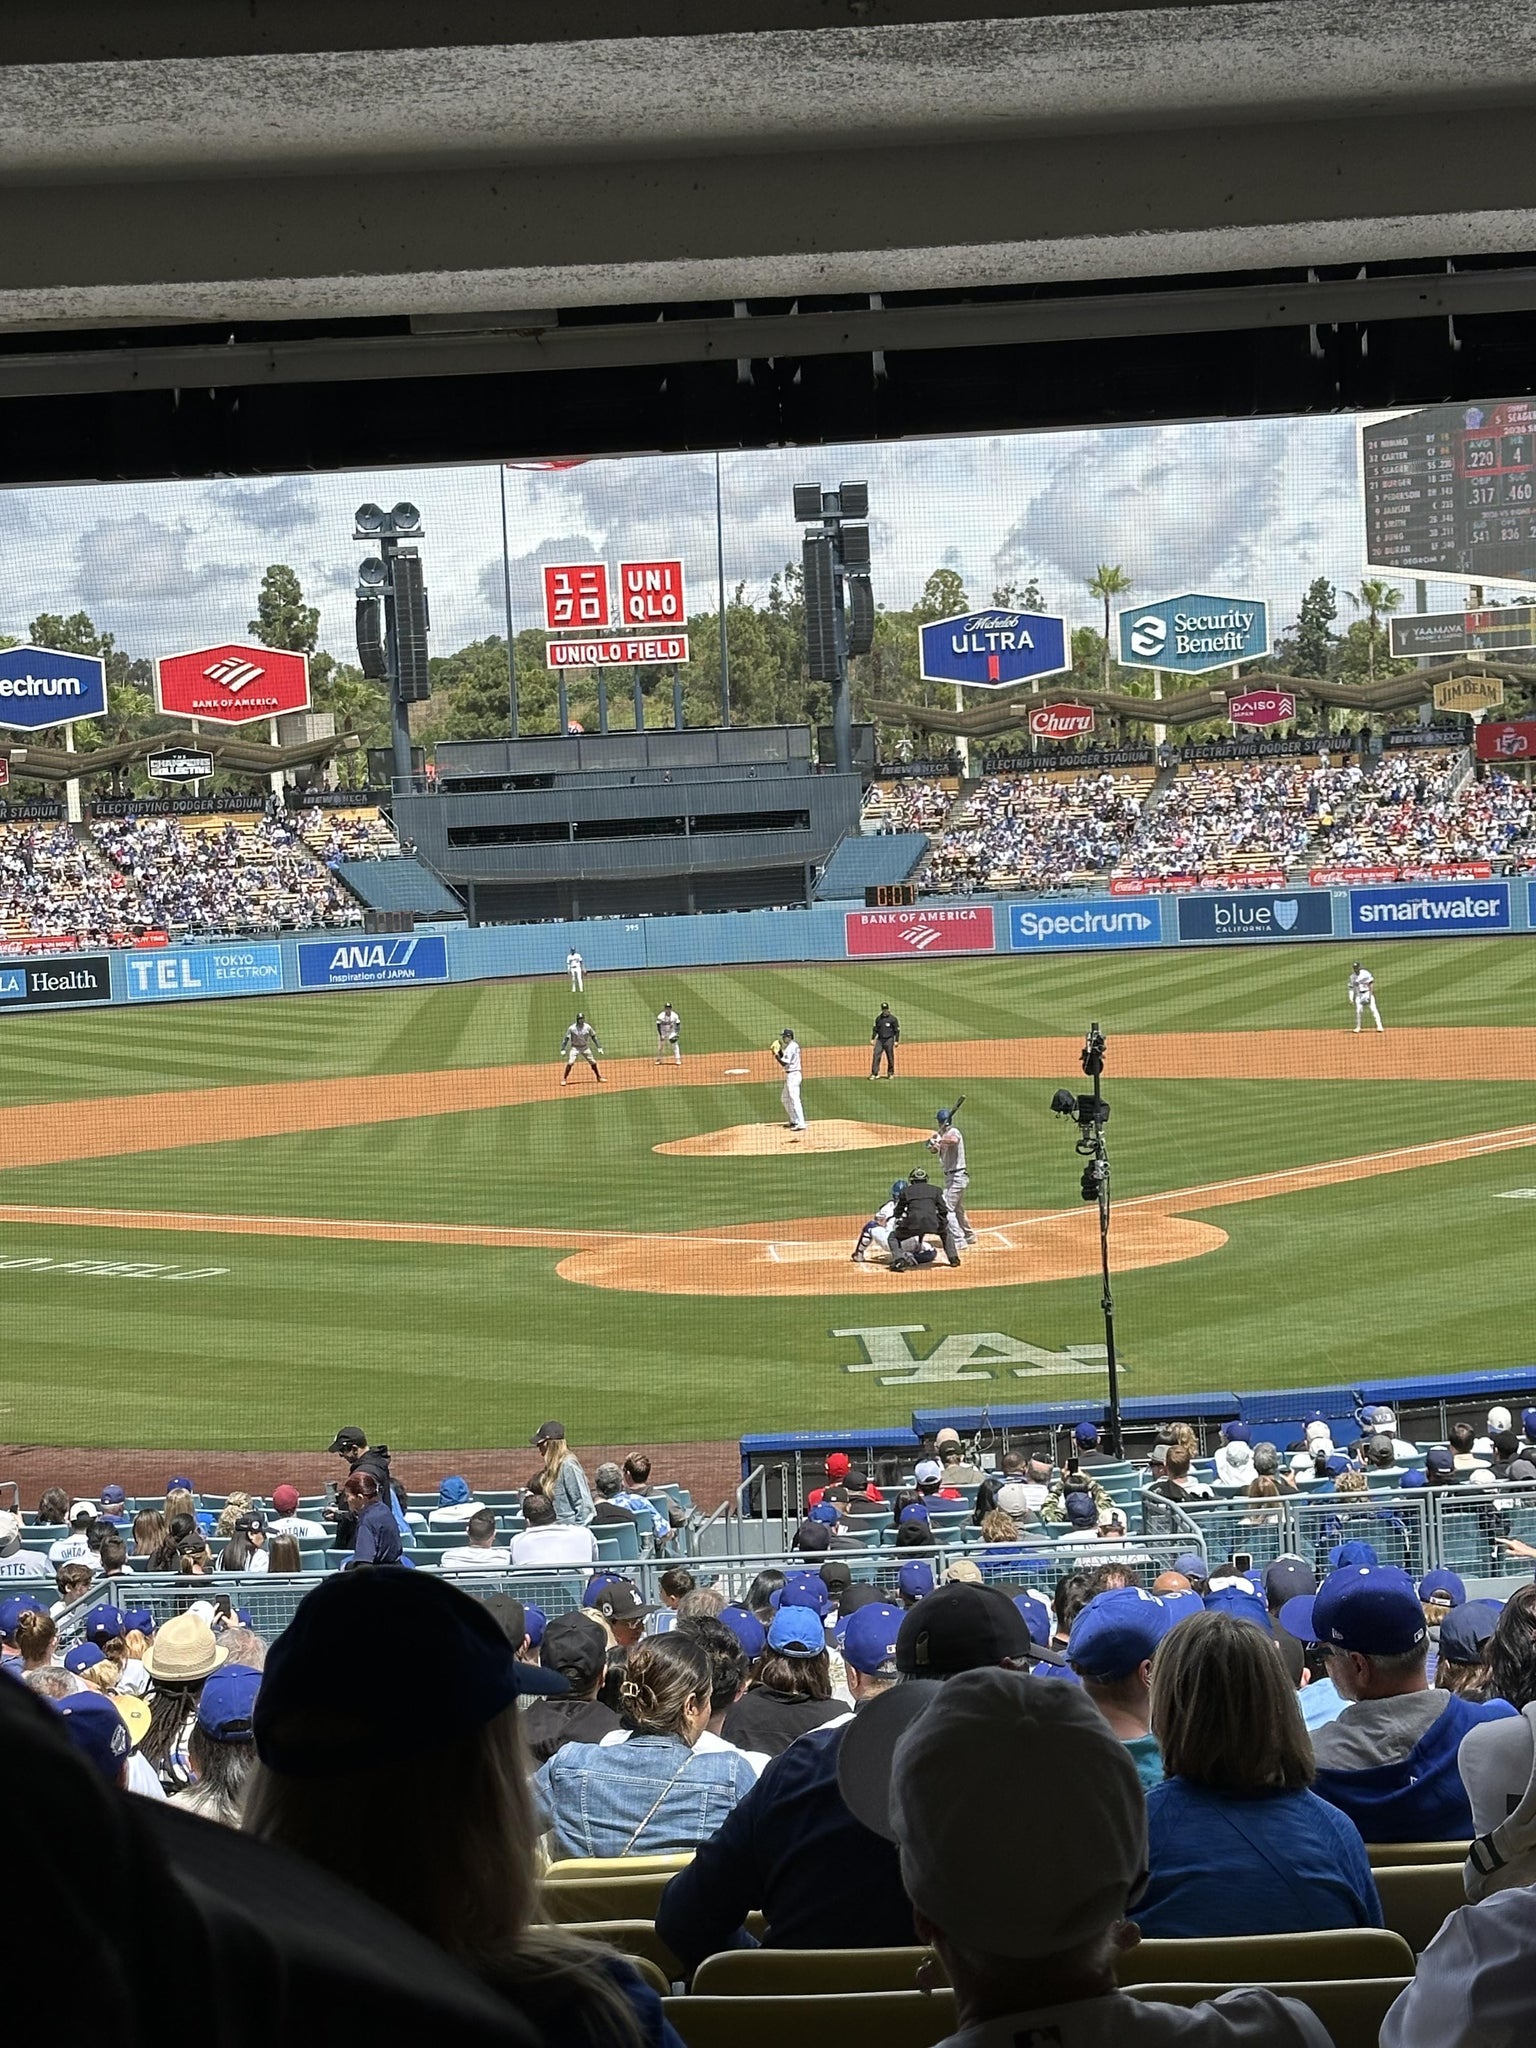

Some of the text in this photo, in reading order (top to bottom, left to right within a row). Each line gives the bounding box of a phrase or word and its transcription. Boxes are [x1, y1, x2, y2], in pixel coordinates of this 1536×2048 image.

[1469, 440, 1491, 448] AVG
[1381, 451, 1408, 462] CARTER
[1467, 451, 1494, 468] .220
[1513, 447, 1521, 463] 4
[1381, 464, 1409, 475] SEAGER
[1427, 461, 1437, 470] SS
[1468, 487, 1495, 504] .317
[1505, 484, 1532, 500] .460
[1469, 530, 1490, 544] .541
[554, 572, 599, 595] ユニ
[627, 569, 672, 592] UNI
[554, 597, 601, 621] クロ
[629, 594, 677, 621] QLO
[963, 614, 1021, 632] Michelob
[1174, 609, 1255, 634] Security
[1471, 612, 1484, 627] T
[951, 630, 1036, 654] ULTRA
[1175, 634, 1245, 655] Benefit
[555, 641, 681, 667] UNIQLO FIELD
[0, 674, 81, 698] ectrum
[1439, 680, 1497, 708] JIM BEAM
[192, 697, 279, 709] BANK OF AMERICA
[1232, 701, 1276, 712] DAISO
[1031, 710, 1092, 733] Churu
[1184, 738, 1351, 759] ELECTRIFYING DODGER STADIUM
[985, 751, 1149, 771] ELECTRIFYING DODGER STADIUM
[11, 806, 59, 818] STADIUM
[96, 798, 263, 815] ELECTRIFYING DODGER STADIUM
[861, 910, 977, 925] BANK OF AMERICA
[1214, 903, 1271, 926] blue
[1359, 896, 1501, 922] smartwater
[624, 924, 640, 932] 395
[1020, 911, 1143, 941] Spectrum
[1215, 925, 1273, 933] CALIFORNIA
[214, 953, 254, 967] TOKYO
[329, 944, 386, 970] ANA
[0, 969, 98, 992] LA Health
[130, 957, 202, 991] TEL
[216, 965, 278, 979] ELECTRON
[329, 969, 415, 984] Inspiration of JAPAN
[831, 1324, 1127, 1386] LA
